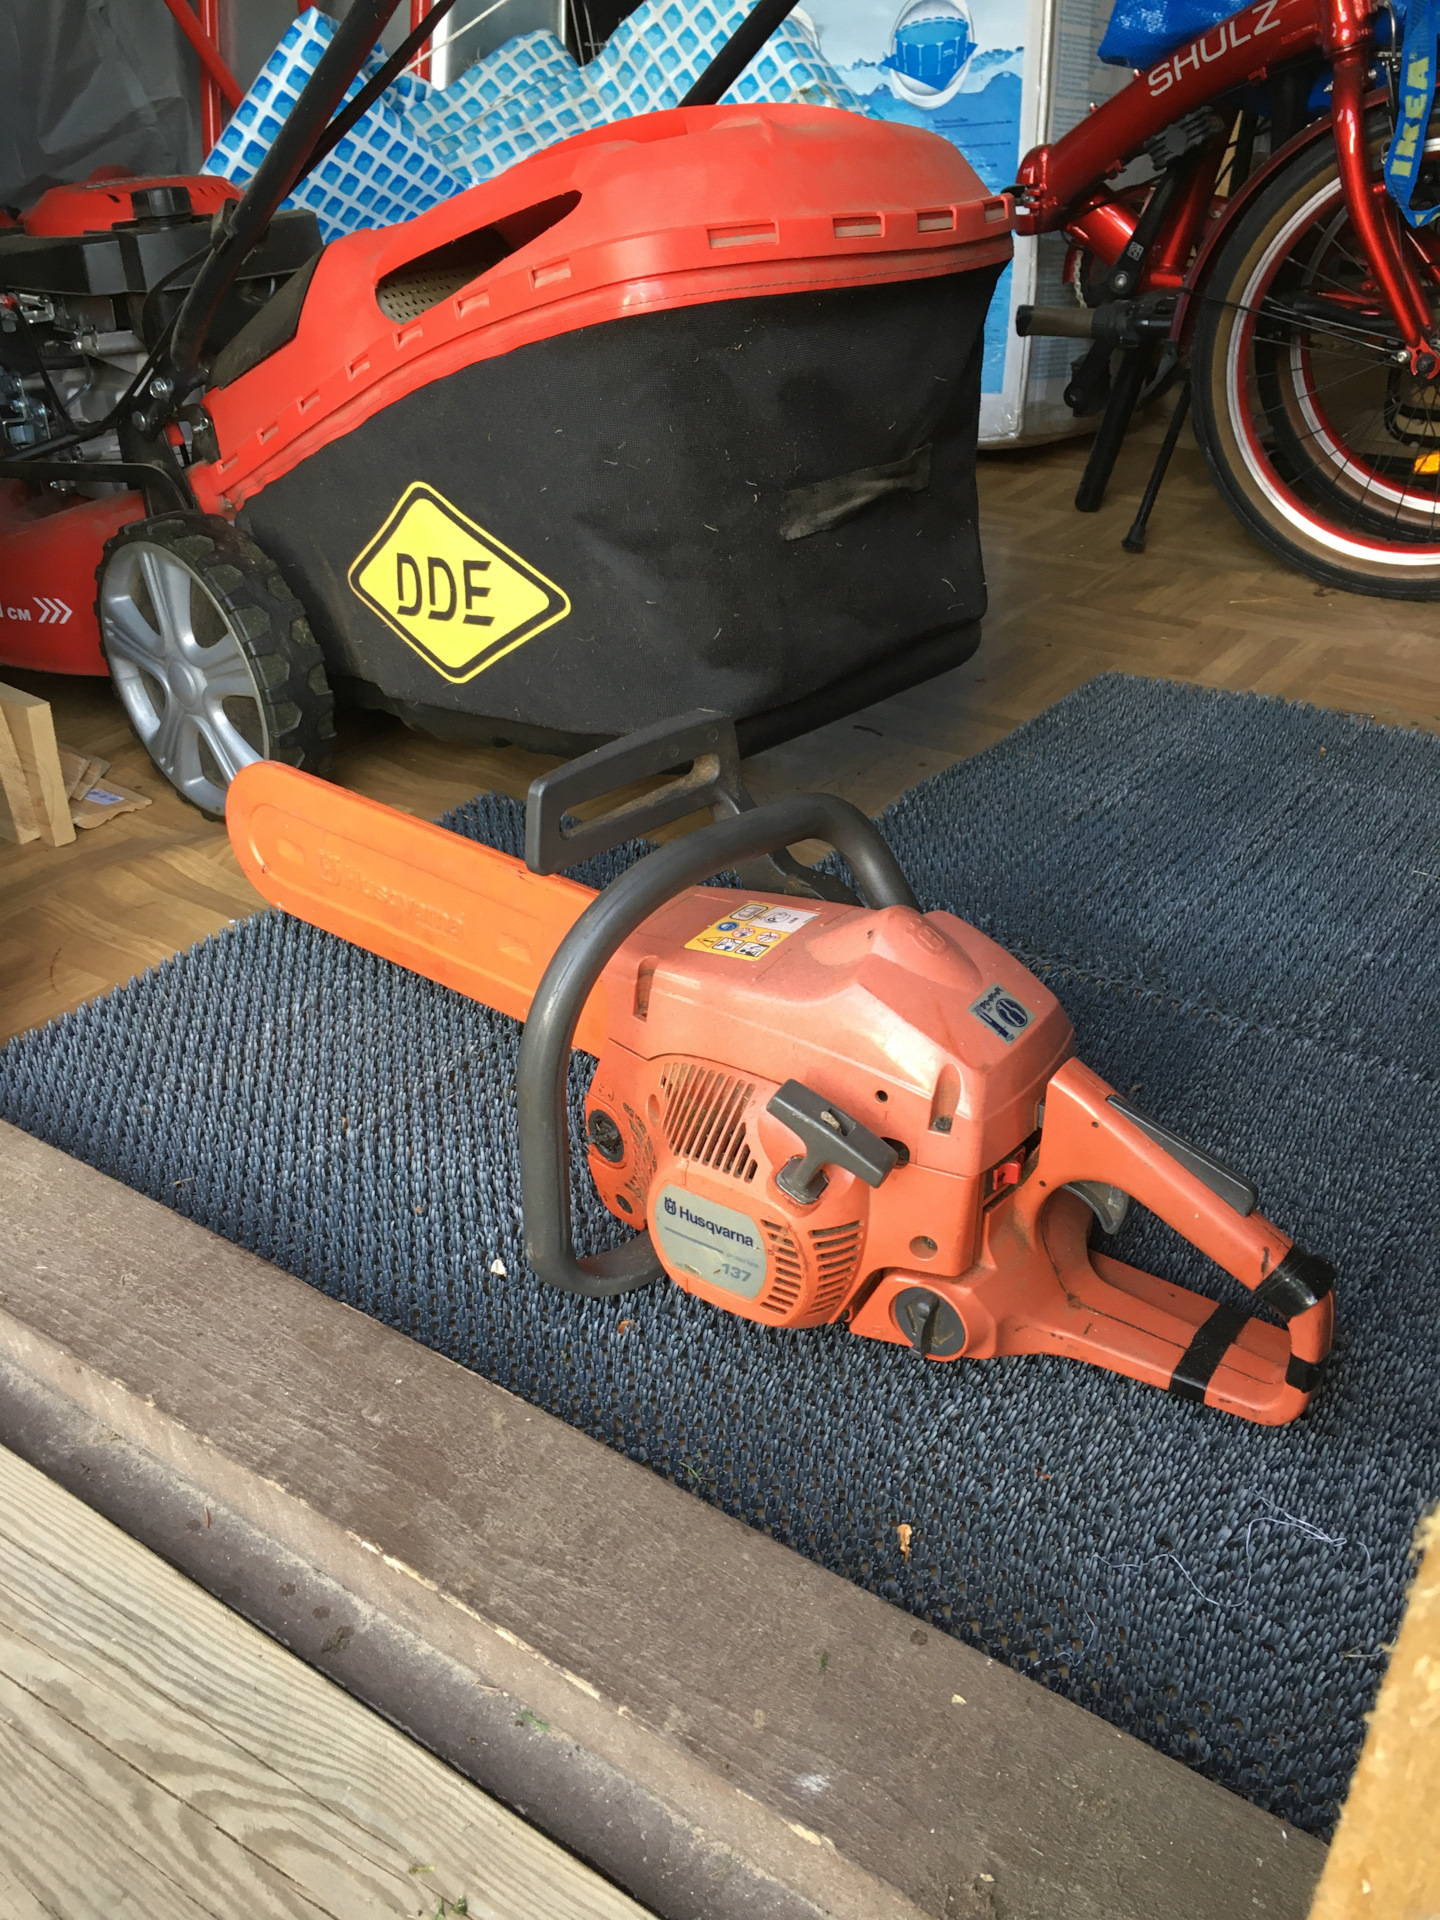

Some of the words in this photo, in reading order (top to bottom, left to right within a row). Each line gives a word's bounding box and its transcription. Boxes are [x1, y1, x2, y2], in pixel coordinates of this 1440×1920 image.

[1148, 0, 1281, 96] SHULZ
[1389, 56, 1430, 178] IKEA
[396, 552, 496, 627] DDE
[680, 1206, 754, 1247] Husqvarna
[721, 1263, 752, 1282] 137
